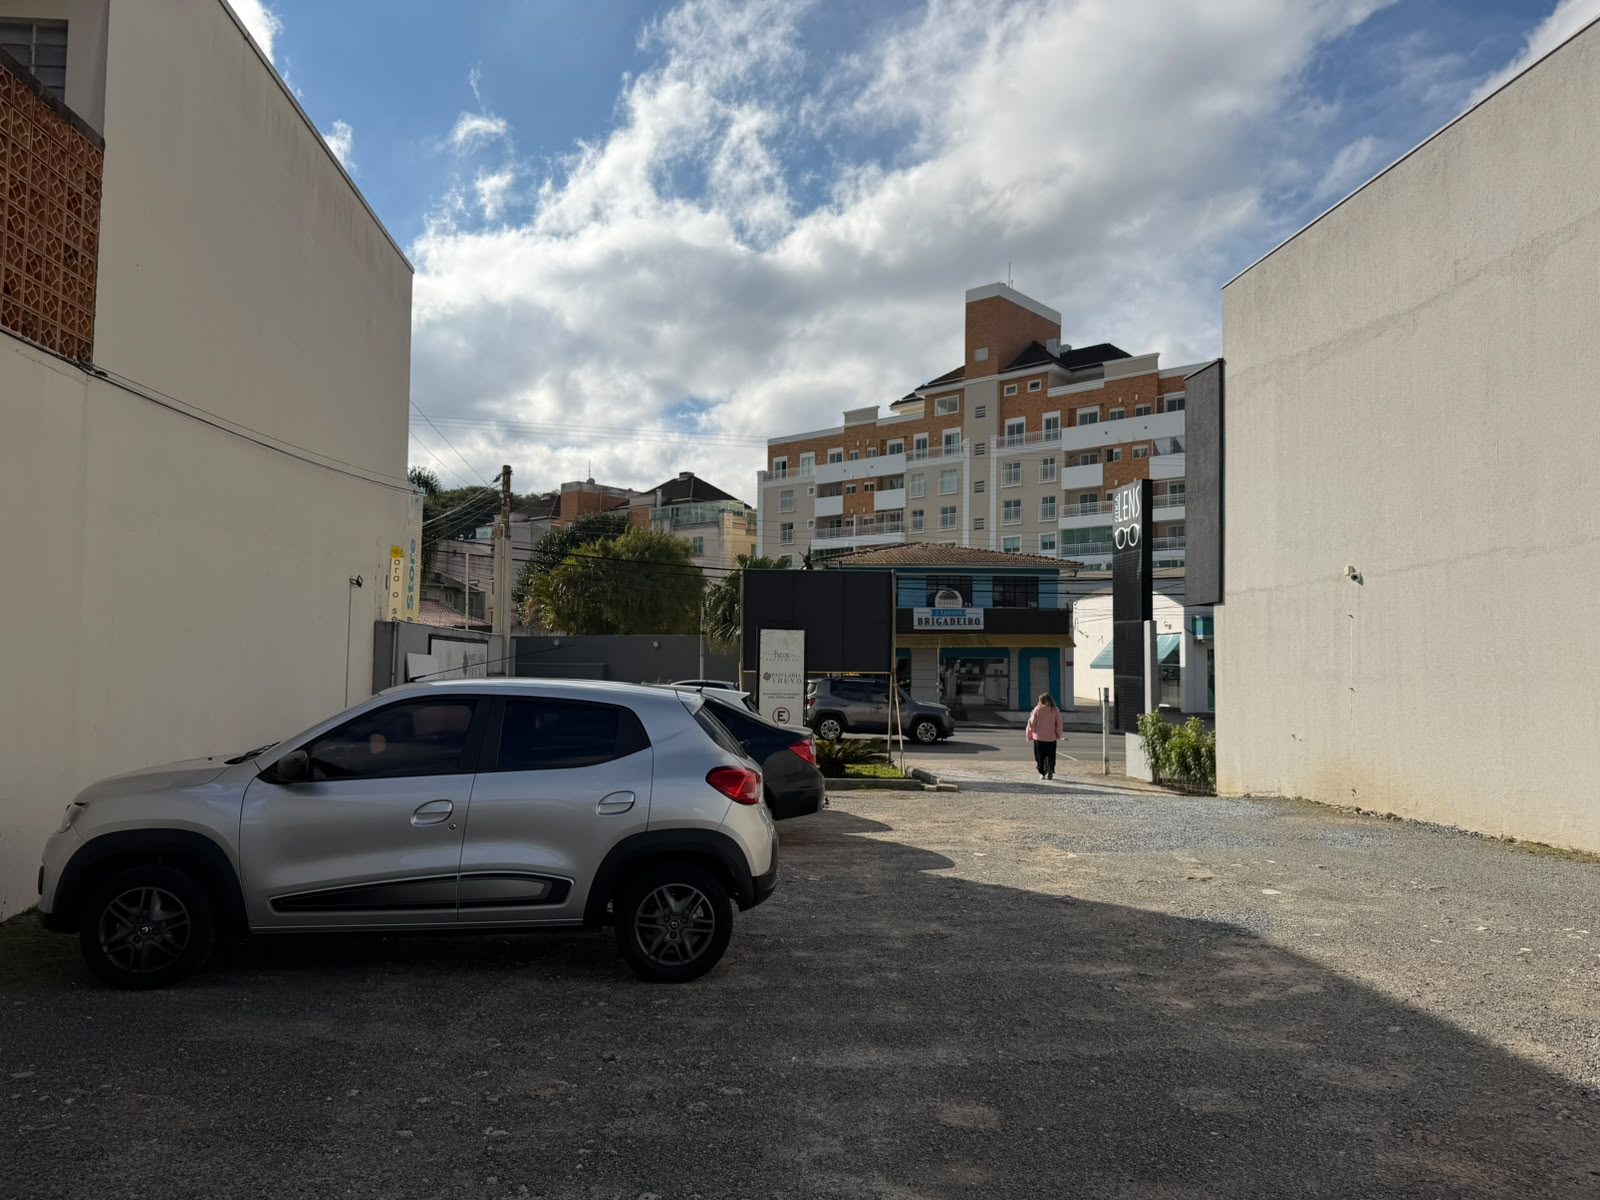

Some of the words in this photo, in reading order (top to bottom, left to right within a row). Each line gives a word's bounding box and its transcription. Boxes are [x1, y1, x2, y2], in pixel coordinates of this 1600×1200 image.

[1119, 485, 1140, 522] LENS
[917, 617, 981, 626] BRIGADEIRO
[778, 711, 786, 722] E
